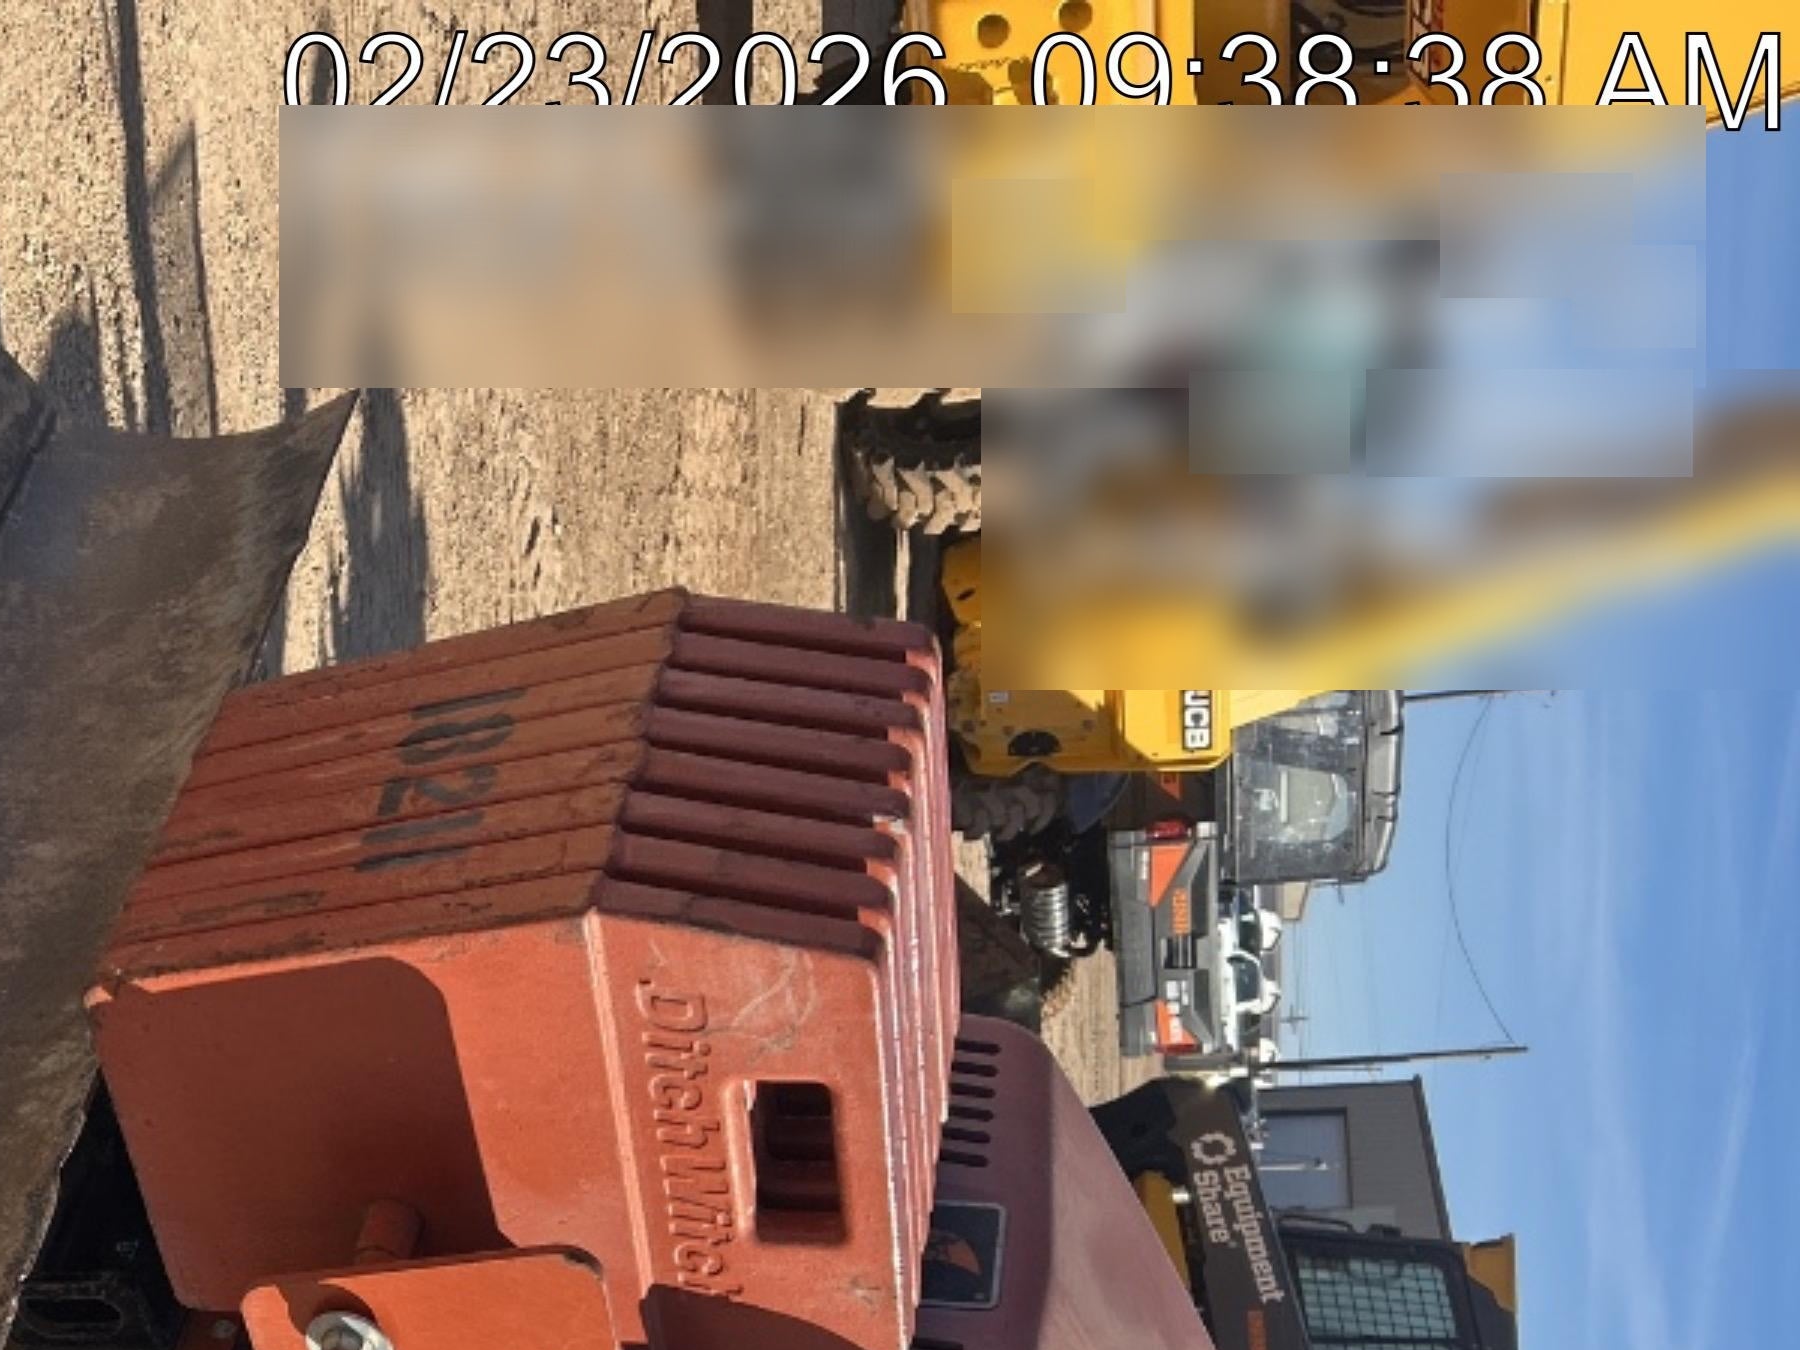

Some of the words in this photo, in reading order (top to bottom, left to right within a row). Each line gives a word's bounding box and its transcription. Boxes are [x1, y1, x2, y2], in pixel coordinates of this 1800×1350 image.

[1183, 689, 1211, 749] JCB
[636, 977, 721, 1149] Ditch
[1191, 1168, 1232, 1244] Share
[1222, 1164, 1286, 1303] Equipment
